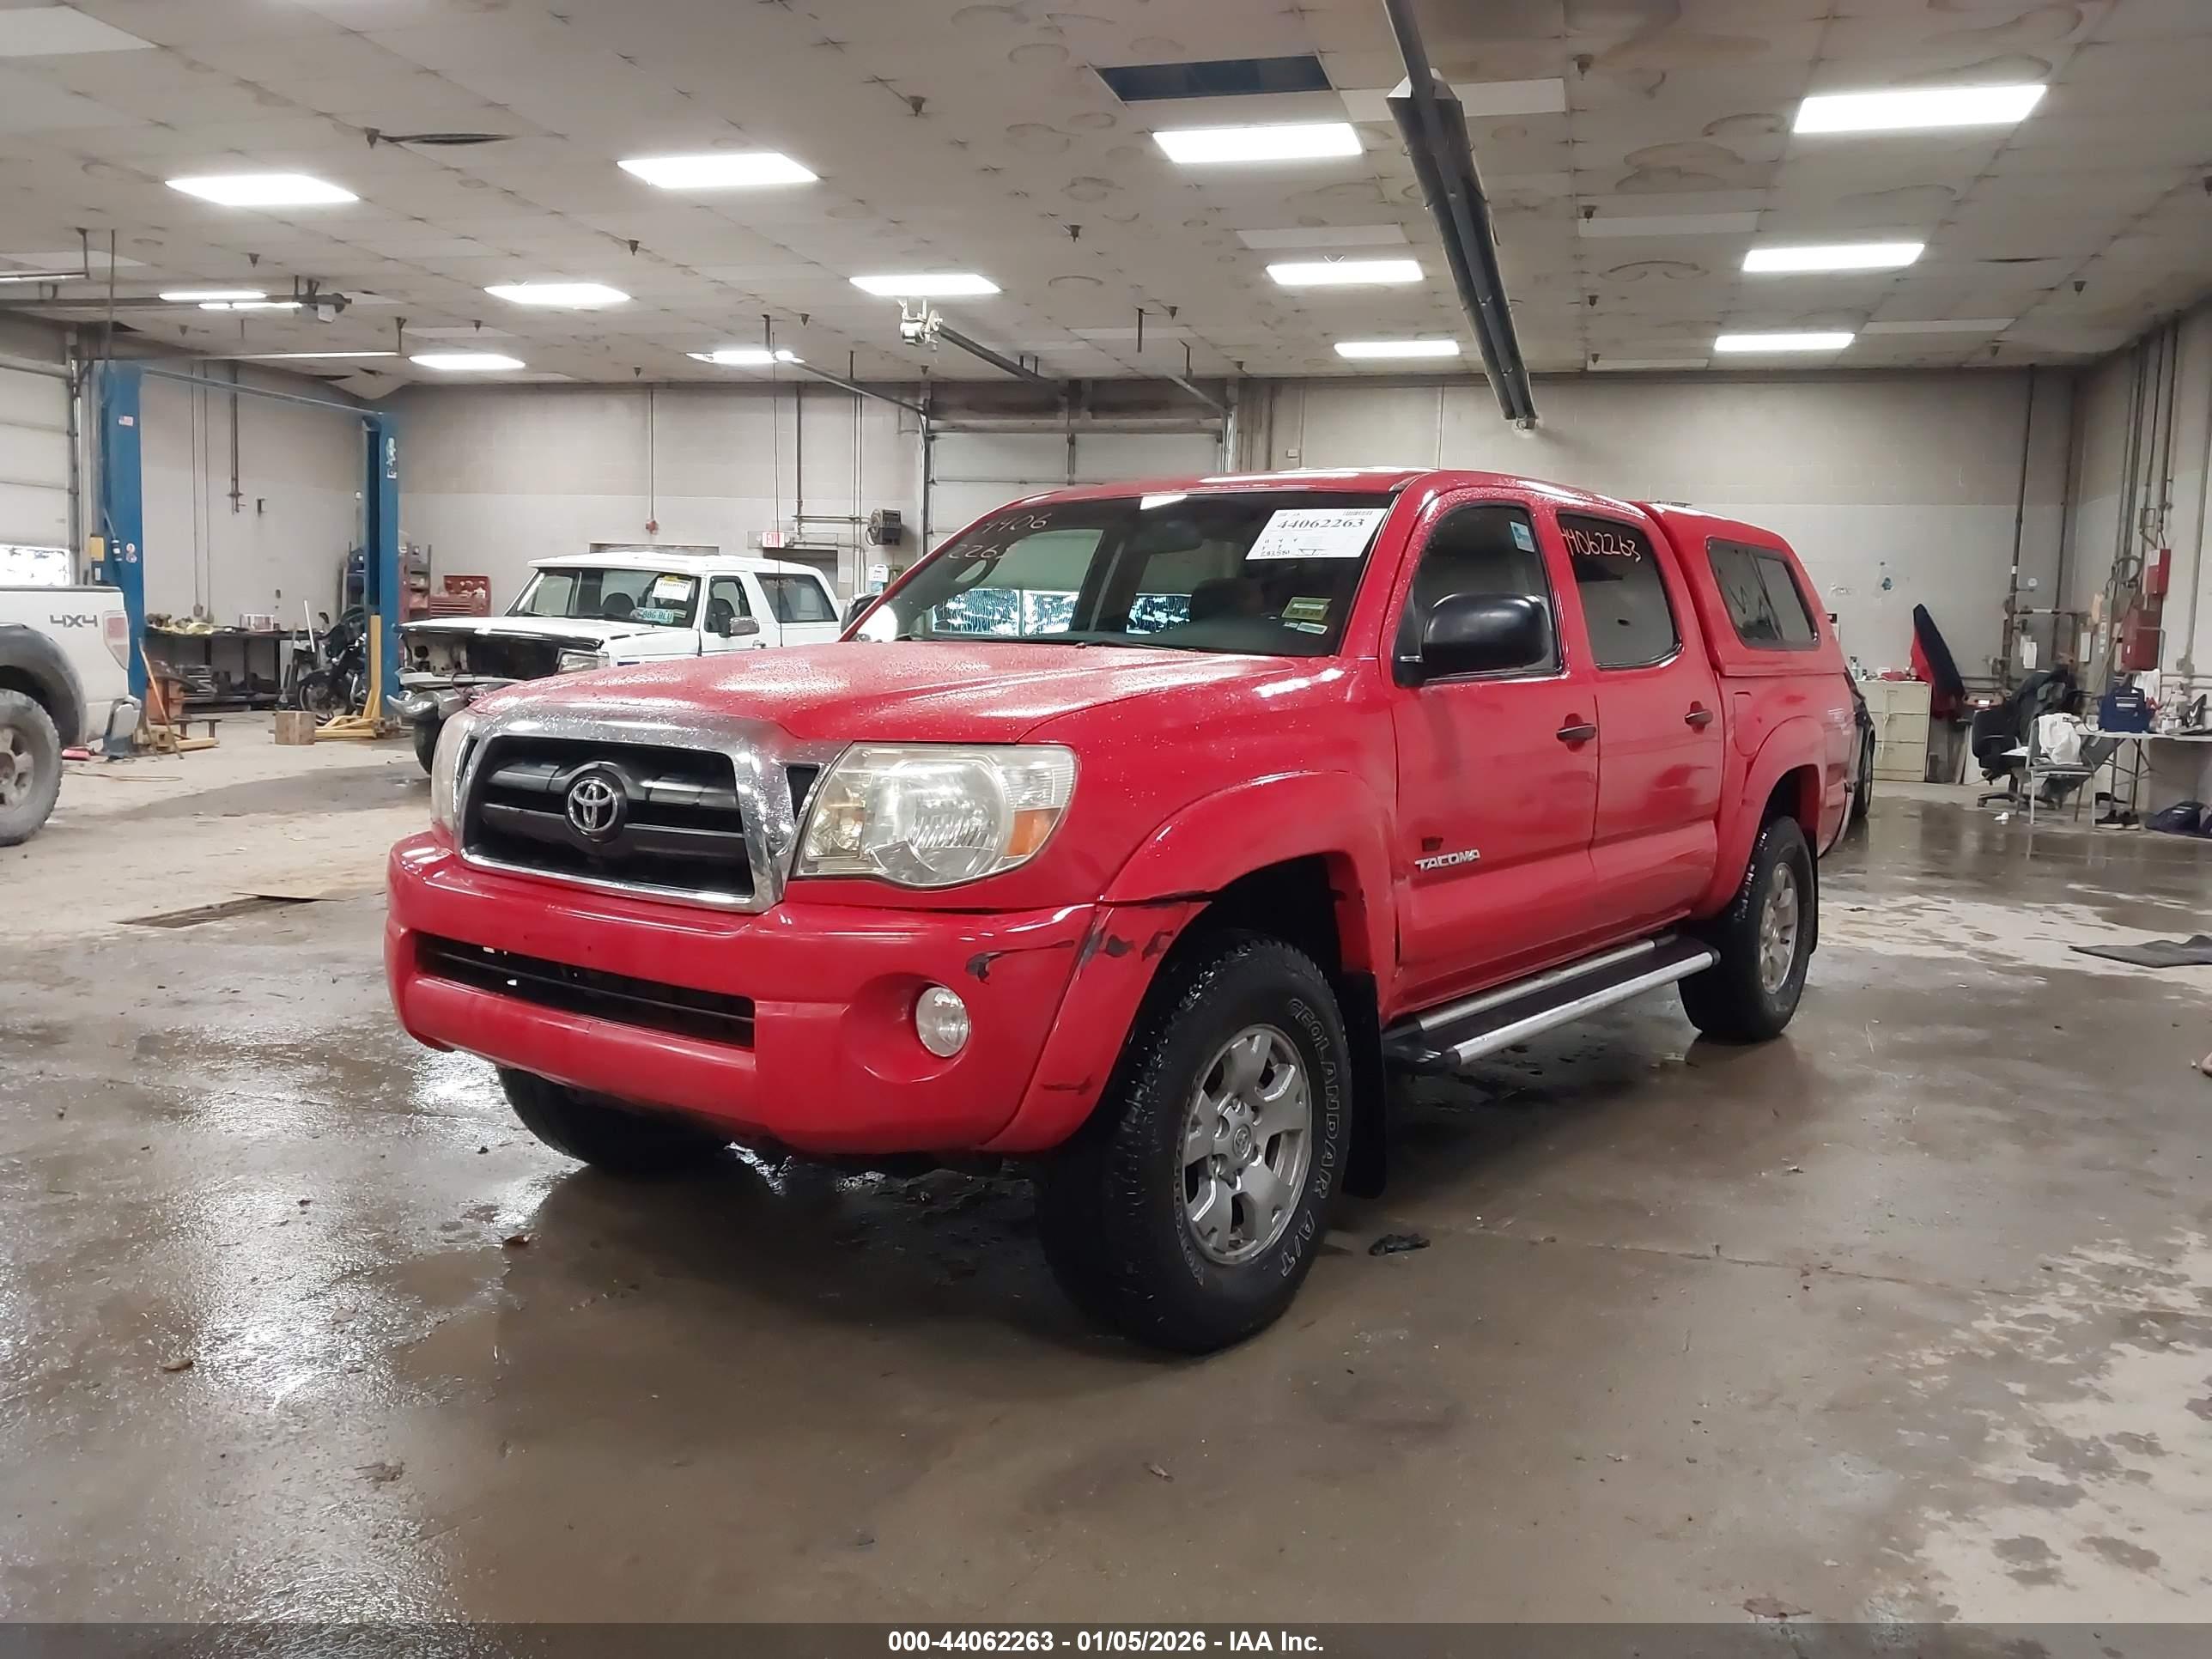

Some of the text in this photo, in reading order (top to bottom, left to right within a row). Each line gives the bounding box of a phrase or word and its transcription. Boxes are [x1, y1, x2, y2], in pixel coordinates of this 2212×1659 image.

[1277, 518, 1365, 529] 44062263
[1414, 849, 1481, 871] TACOMA
[1288, 997, 1340, 1200] GEOLANDAR
